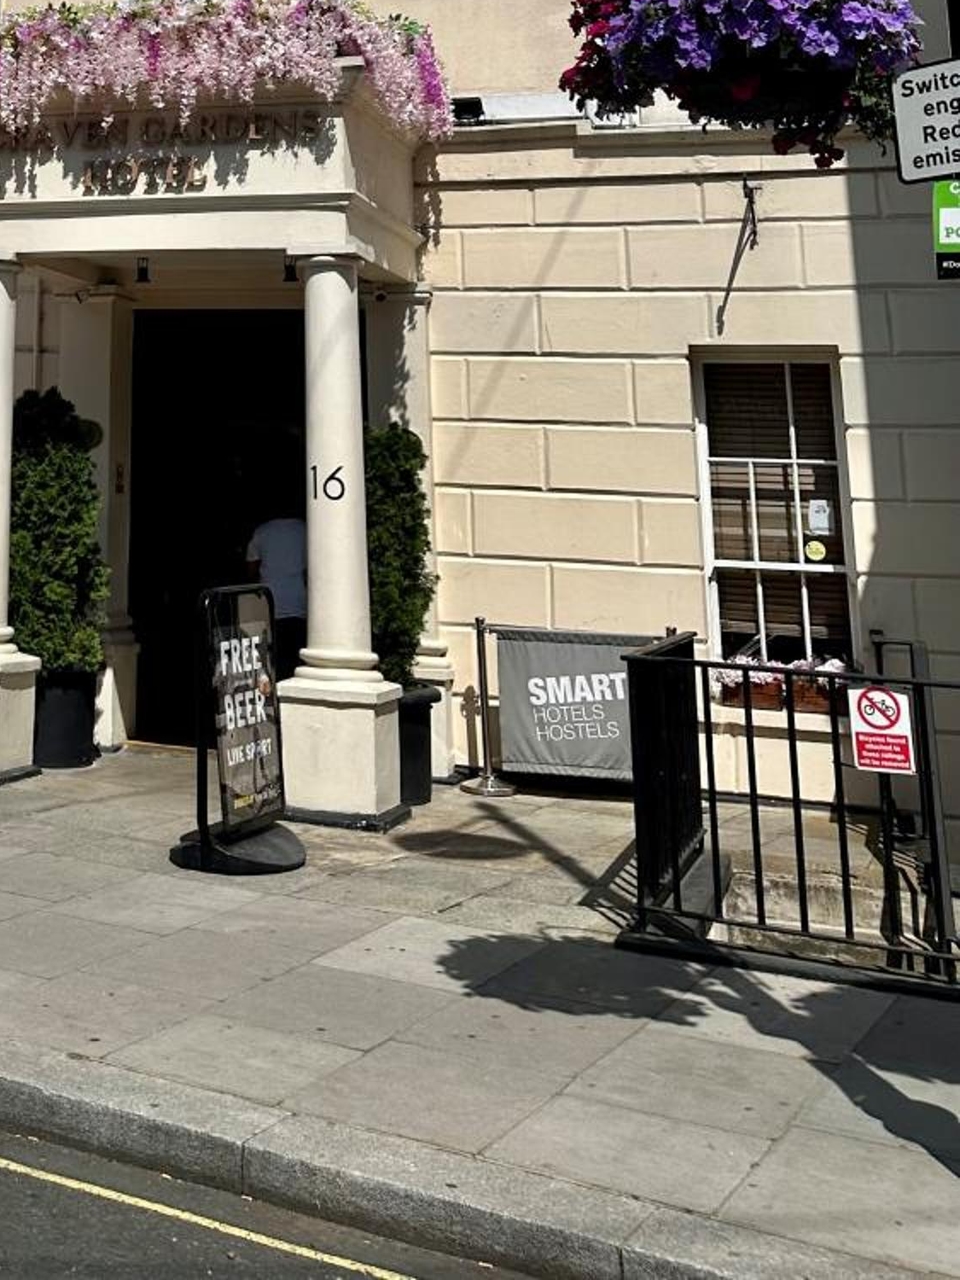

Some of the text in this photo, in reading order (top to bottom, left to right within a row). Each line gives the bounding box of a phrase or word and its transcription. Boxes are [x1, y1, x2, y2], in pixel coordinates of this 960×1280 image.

[142, 109, 321, 143] GARDENS
[82, 154, 207, 193] HOTEL
[310, 465, 345, 500] 16
[220, 636, 262, 676] FREE
[528, 672, 627, 705] SMART
[224, 688, 267, 730] BEER
[533, 704, 605, 723] HOTELS
[536, 721, 620, 741] HOSTELS
[227, 746, 245, 767] LIVE
